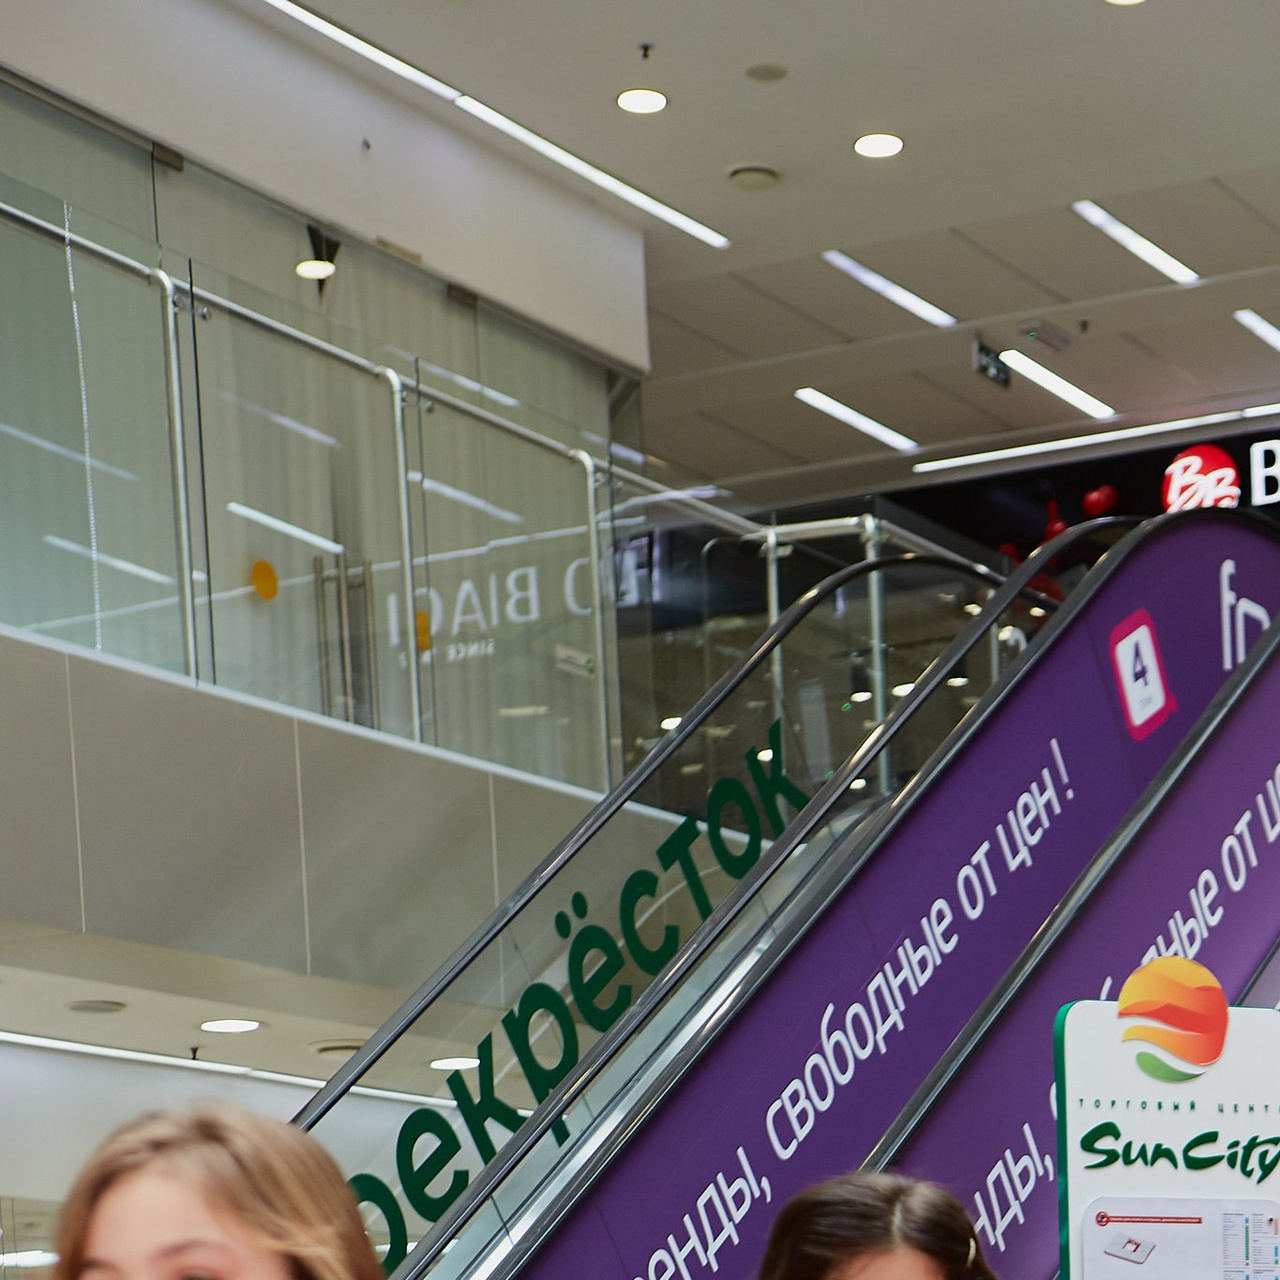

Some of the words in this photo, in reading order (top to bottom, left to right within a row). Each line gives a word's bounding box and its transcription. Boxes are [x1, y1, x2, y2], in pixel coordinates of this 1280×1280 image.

[1132, 640, 1149, 686] 4
[766, 898, 960, 1160] свободные
[1078, 1098, 1196, 1111] ТОРГОВЫЙ
